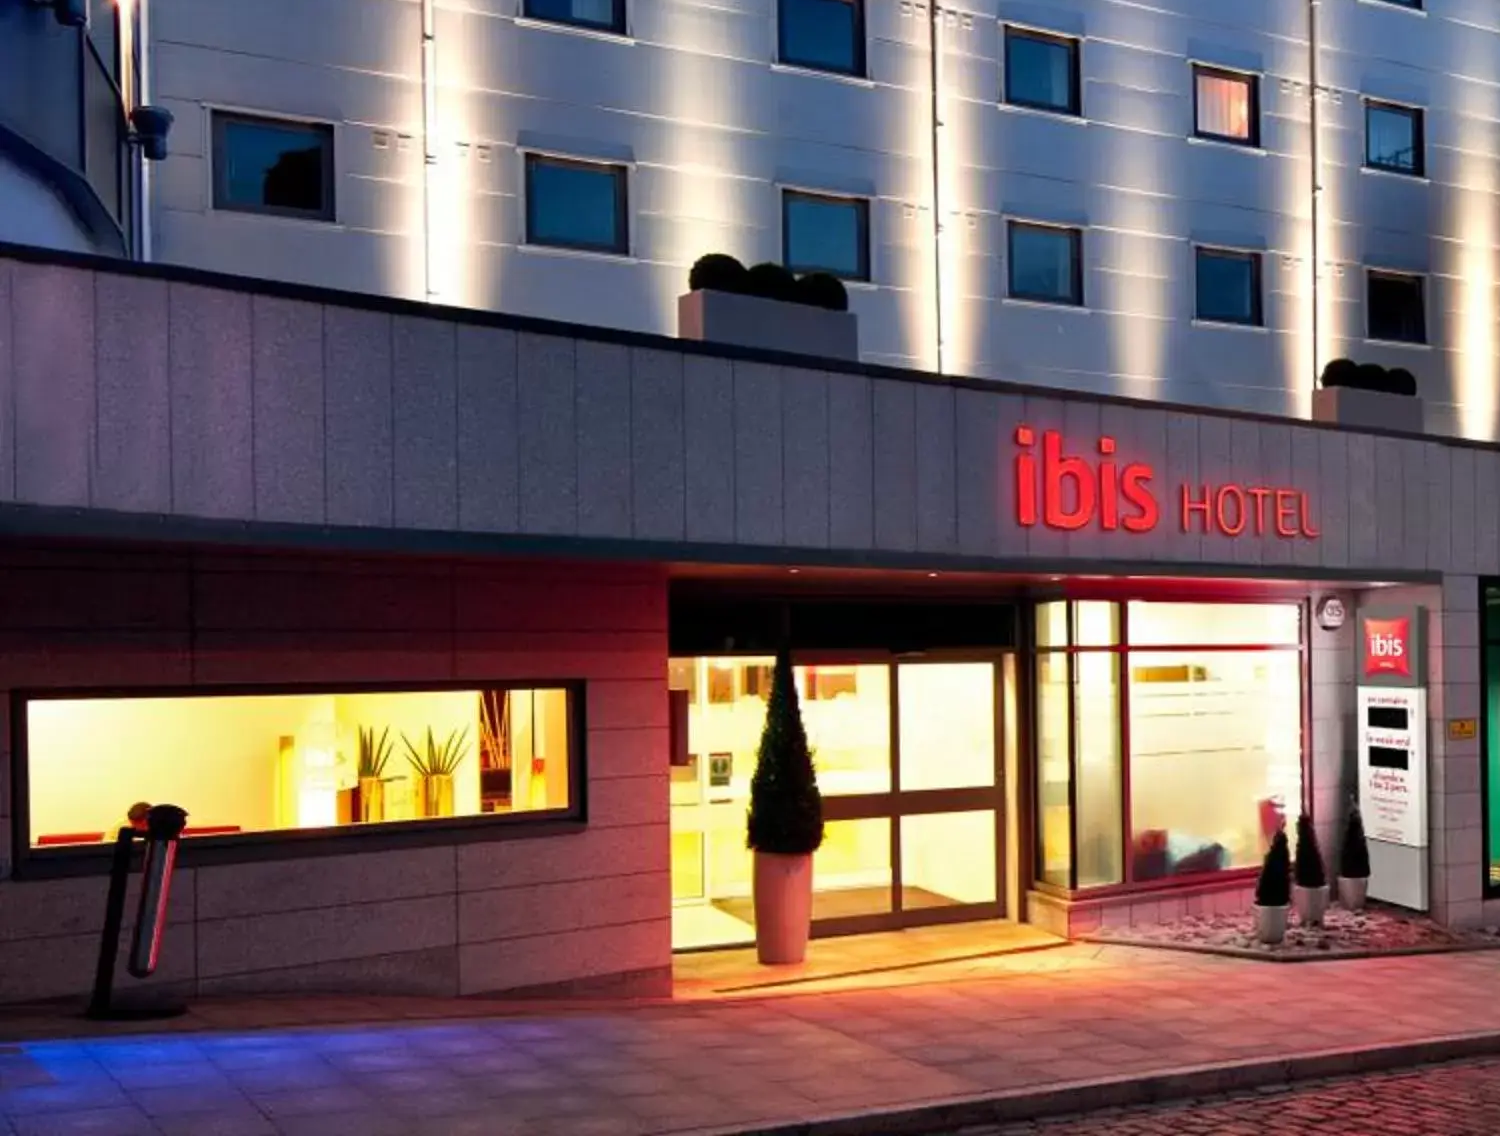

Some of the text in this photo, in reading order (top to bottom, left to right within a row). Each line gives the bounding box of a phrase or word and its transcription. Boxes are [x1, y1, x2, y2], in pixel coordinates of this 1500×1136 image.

[1015, 426, 1321, 539] ibis HOTEL
[1370, 633, 1403, 657] ibis
